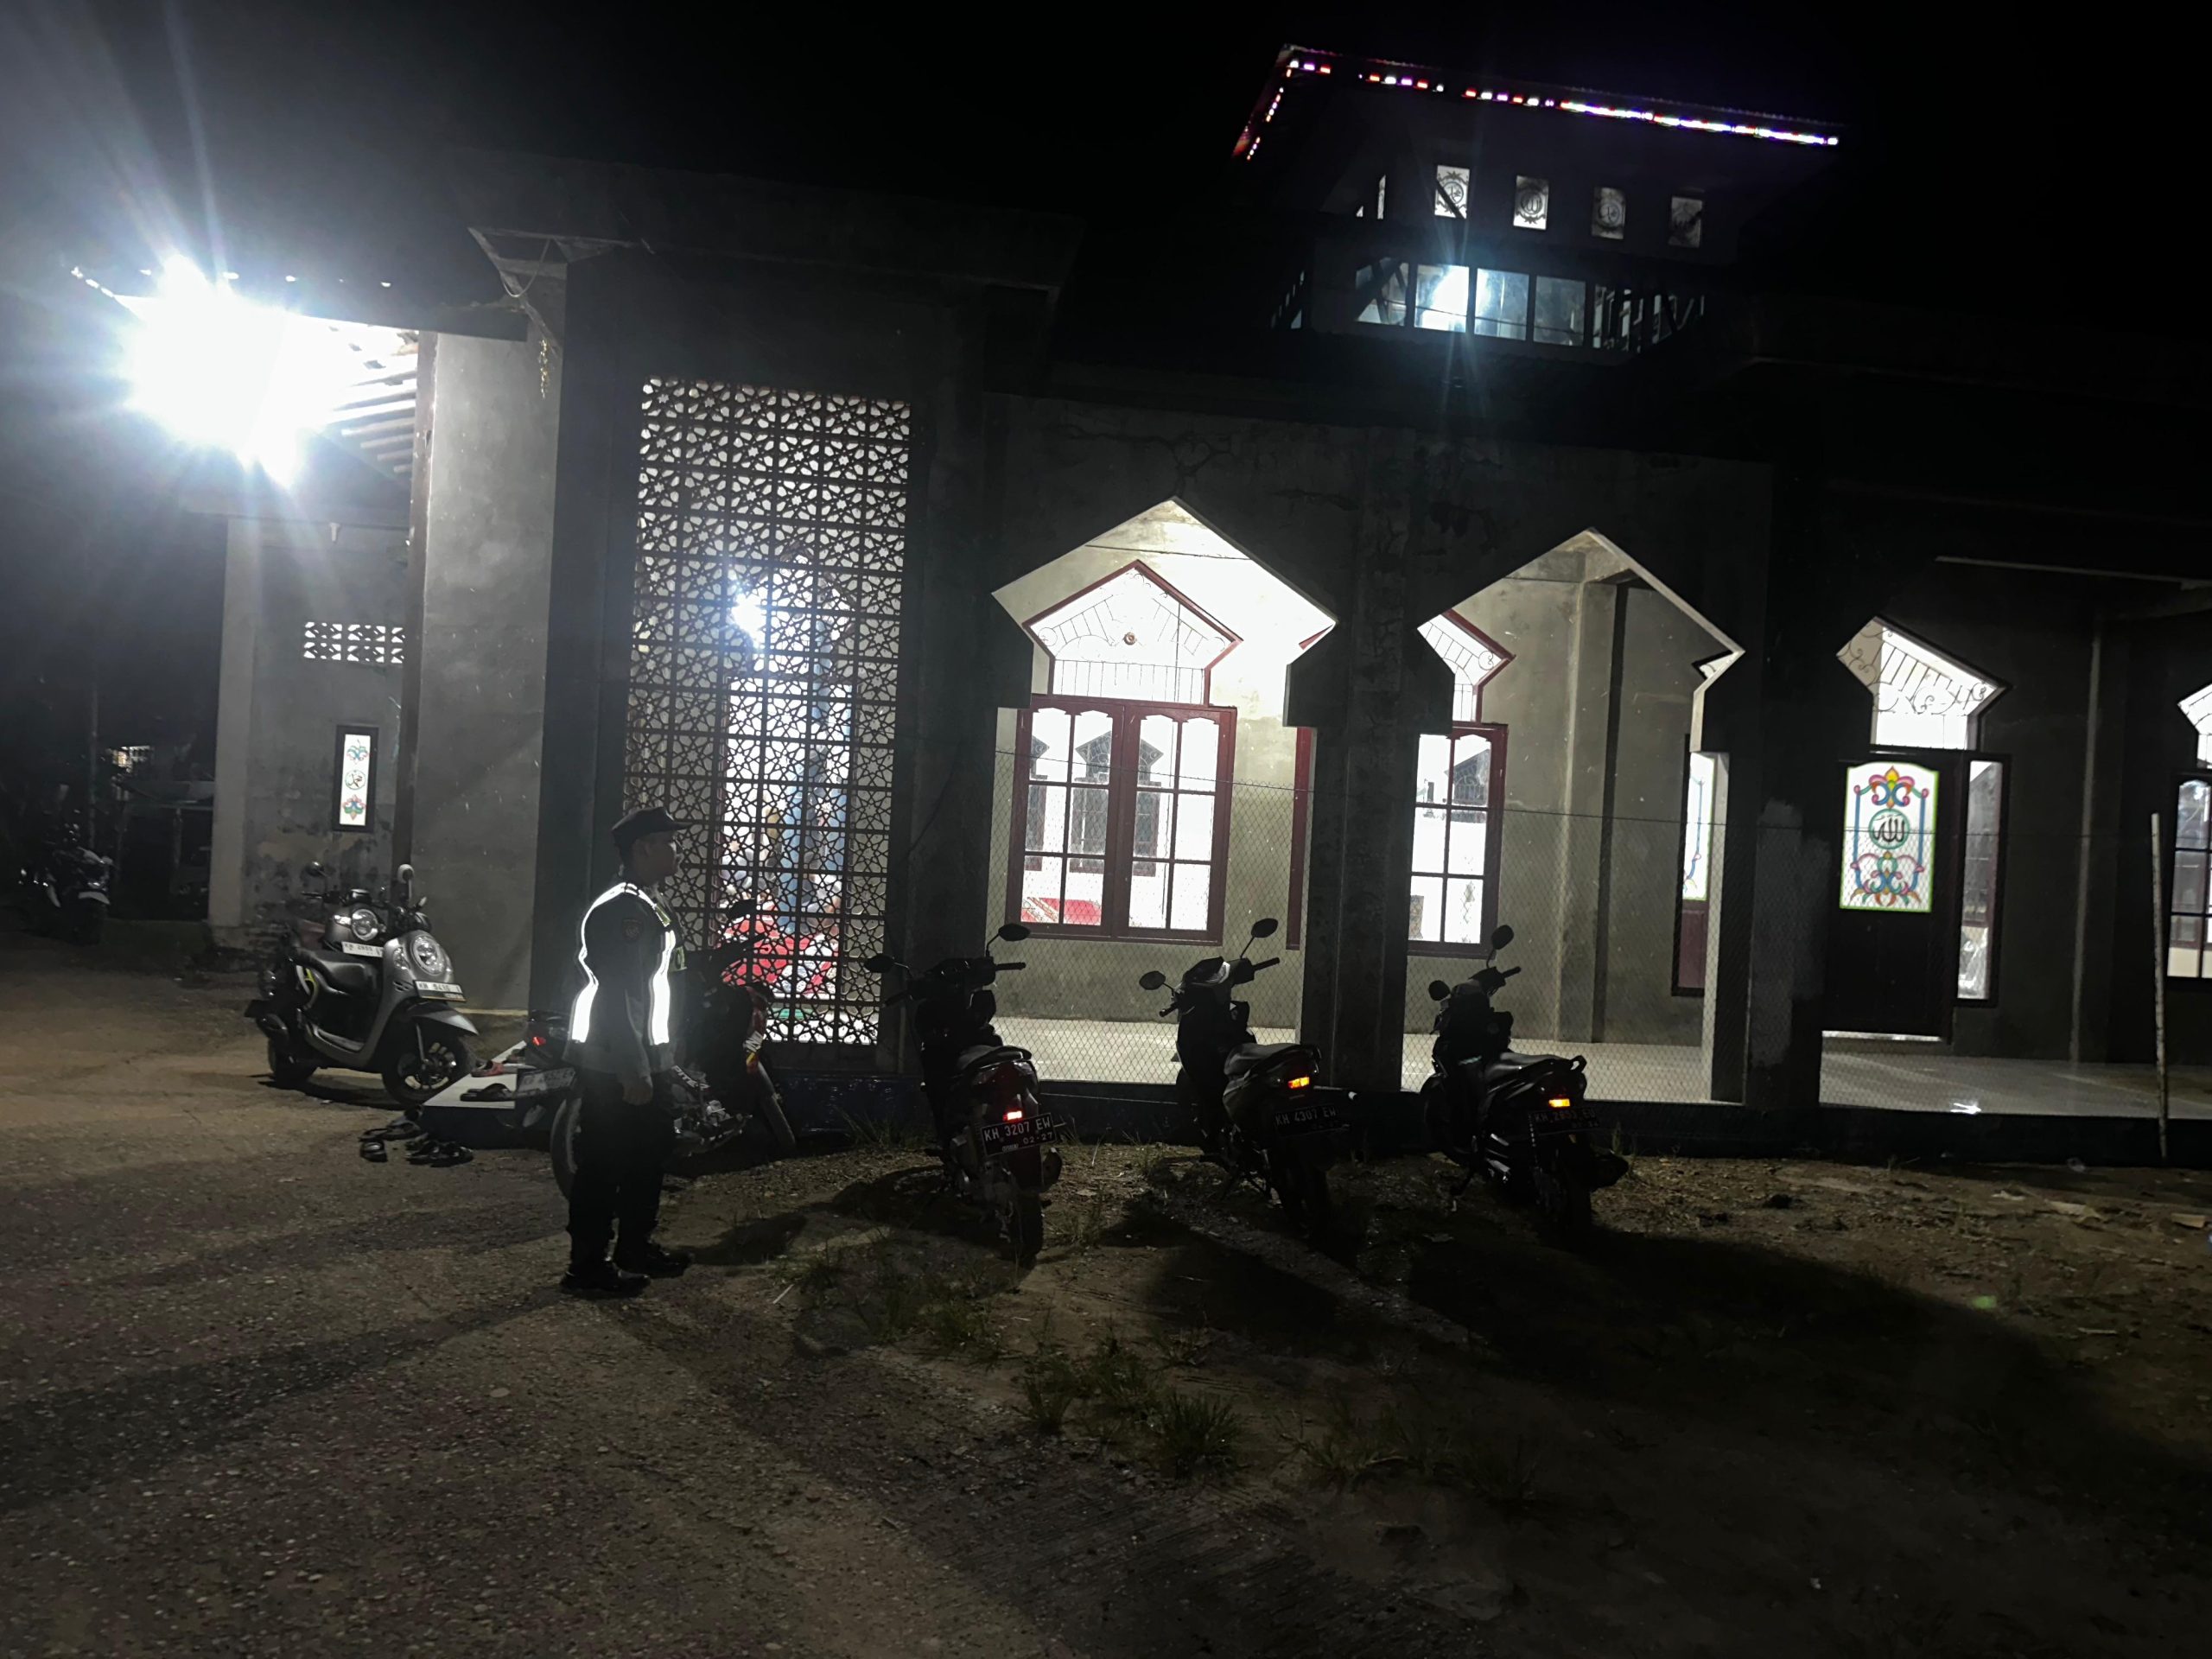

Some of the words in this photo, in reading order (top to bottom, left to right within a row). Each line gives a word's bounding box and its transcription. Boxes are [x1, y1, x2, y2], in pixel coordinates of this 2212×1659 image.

[983, 1128, 1000, 1141] KH
[1005, 1122, 1030, 1137] 3207
[1035, 1116, 1051, 1131] EW
[1274, 1112, 1291, 1127] KH
[1294, 1108, 1319, 1122] 4307
